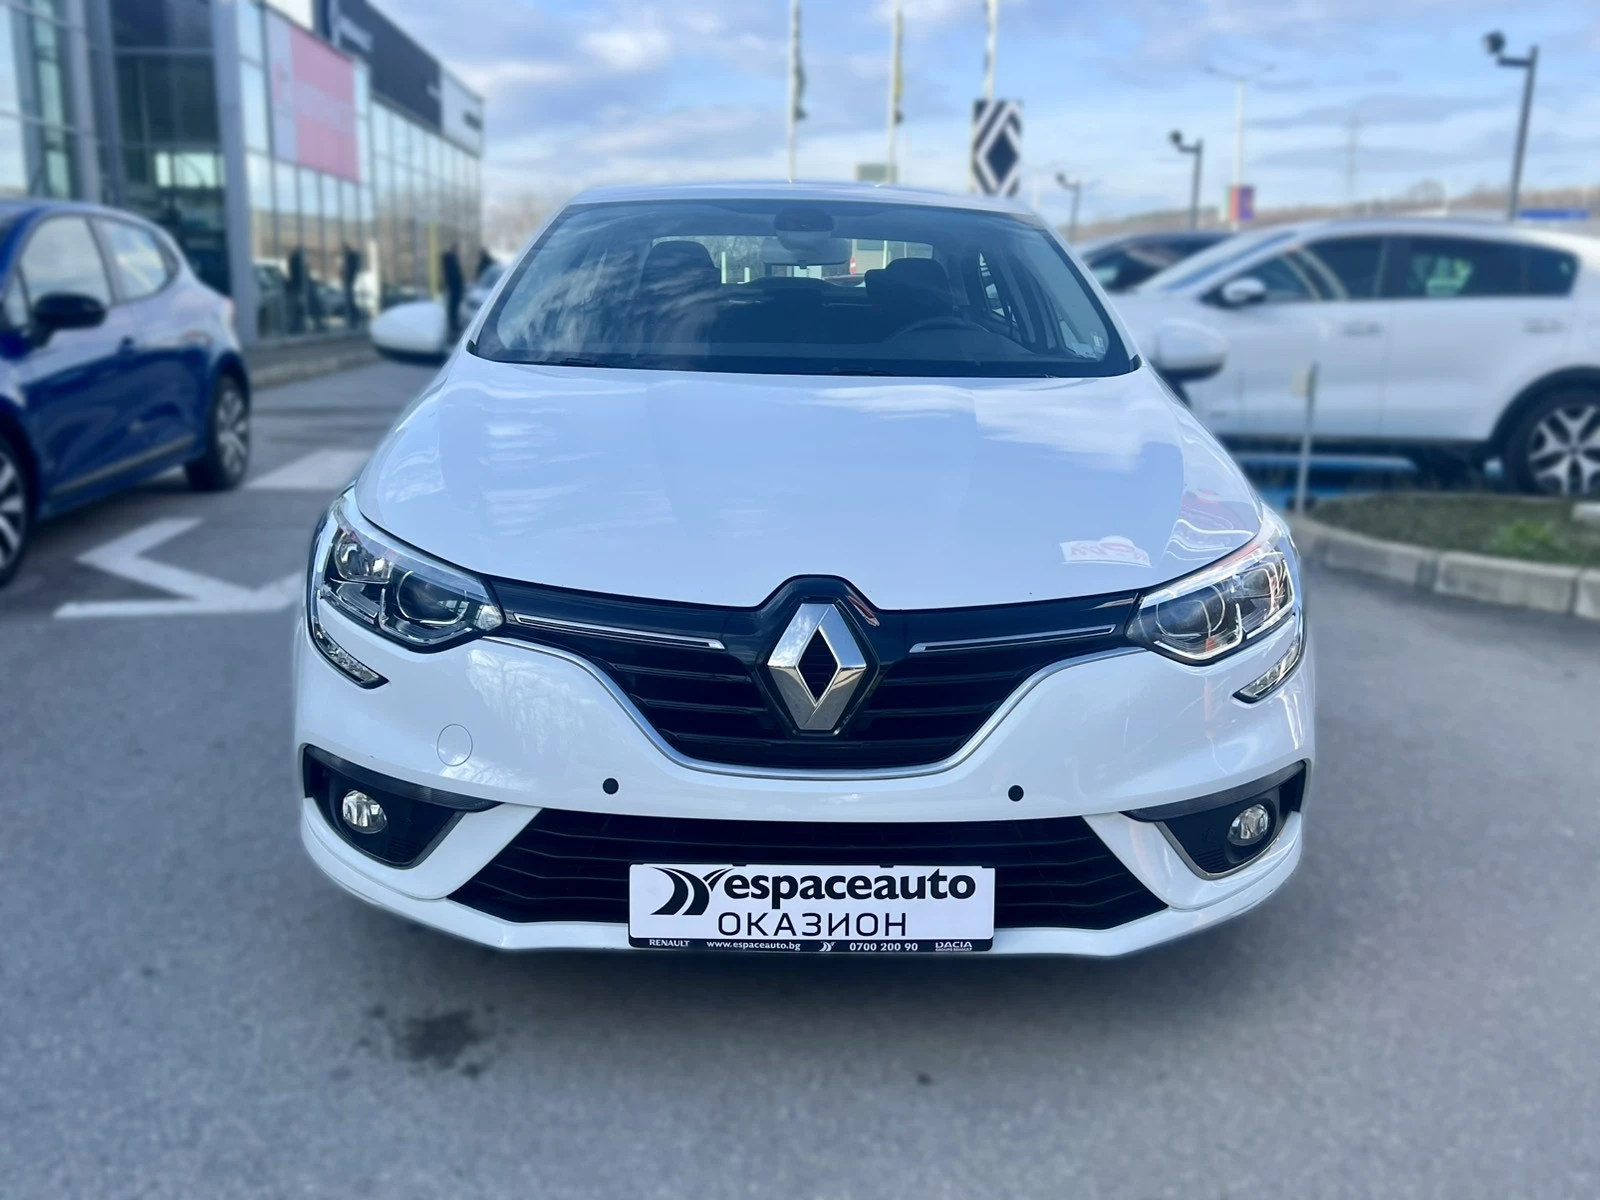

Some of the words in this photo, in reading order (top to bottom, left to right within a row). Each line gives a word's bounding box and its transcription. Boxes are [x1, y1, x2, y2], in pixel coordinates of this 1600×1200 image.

[724, 868, 976, 909] espaceauto
[717, 912, 907, 937] ОКАЗИОН
[649, 939, 690, 947] RENAULT
[706, 940, 801, 951] www.espaceauto.bg
[849, 942, 877, 951] 0700
[880, 942, 901, 951] 200
[904, 942, 919, 951] 90
